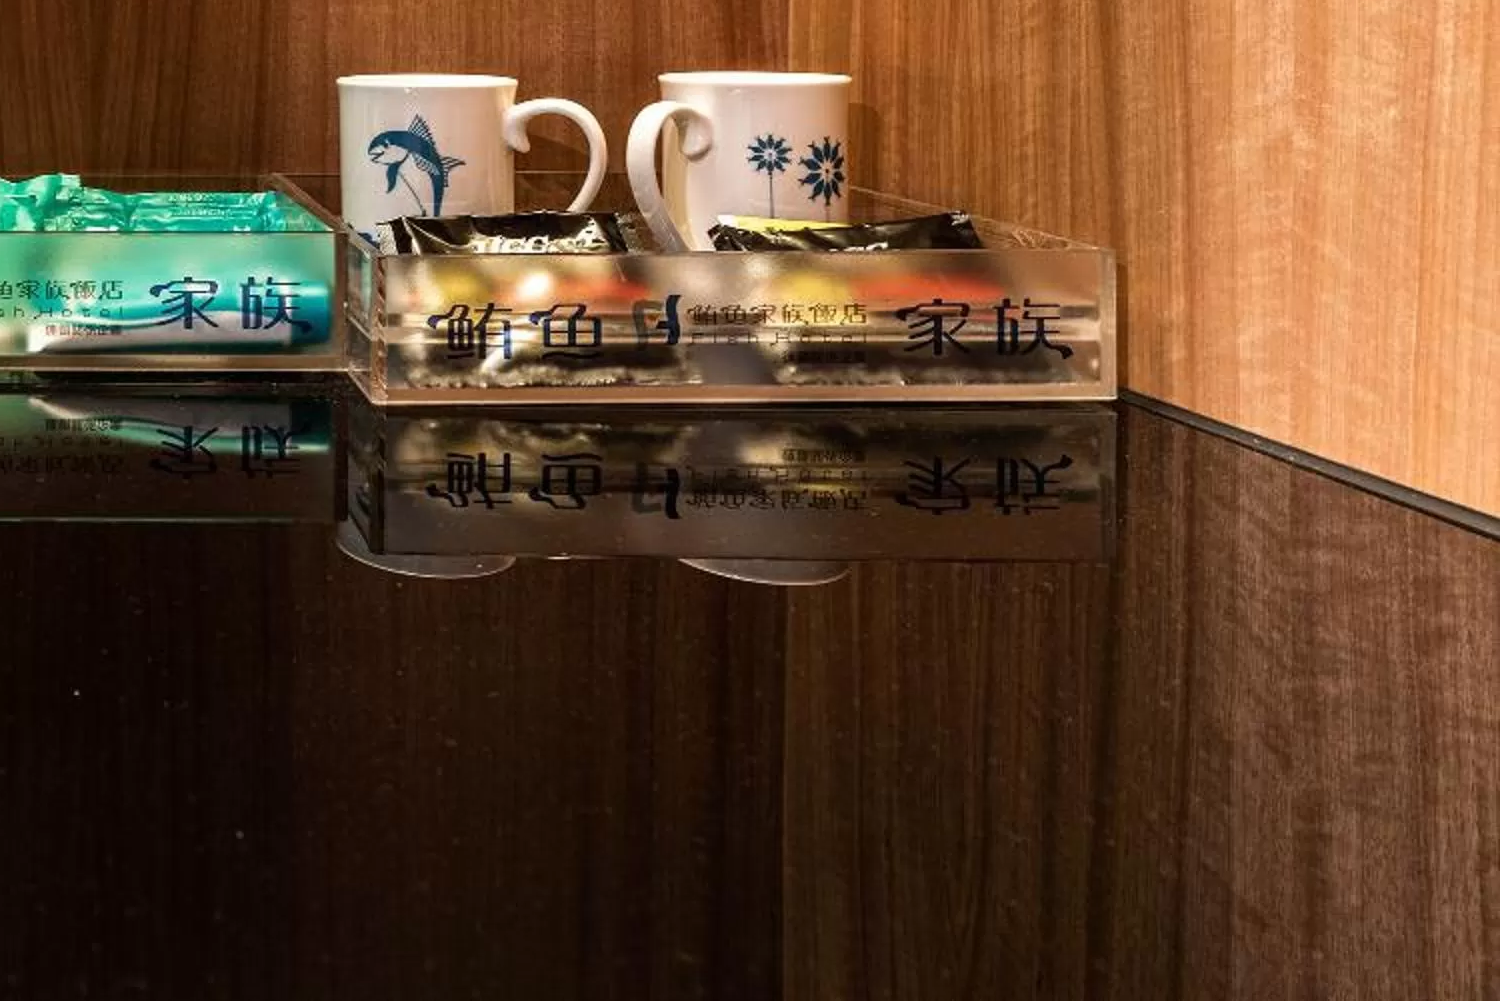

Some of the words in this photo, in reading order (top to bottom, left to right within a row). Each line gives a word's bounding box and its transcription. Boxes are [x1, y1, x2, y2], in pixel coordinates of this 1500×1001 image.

[149, 276, 313, 334] 家族
[427, 302, 602, 360] 鮪魚
[895, 298, 1074, 360] 家族
[687, 302, 868, 326] 鮪魚家族飯店
